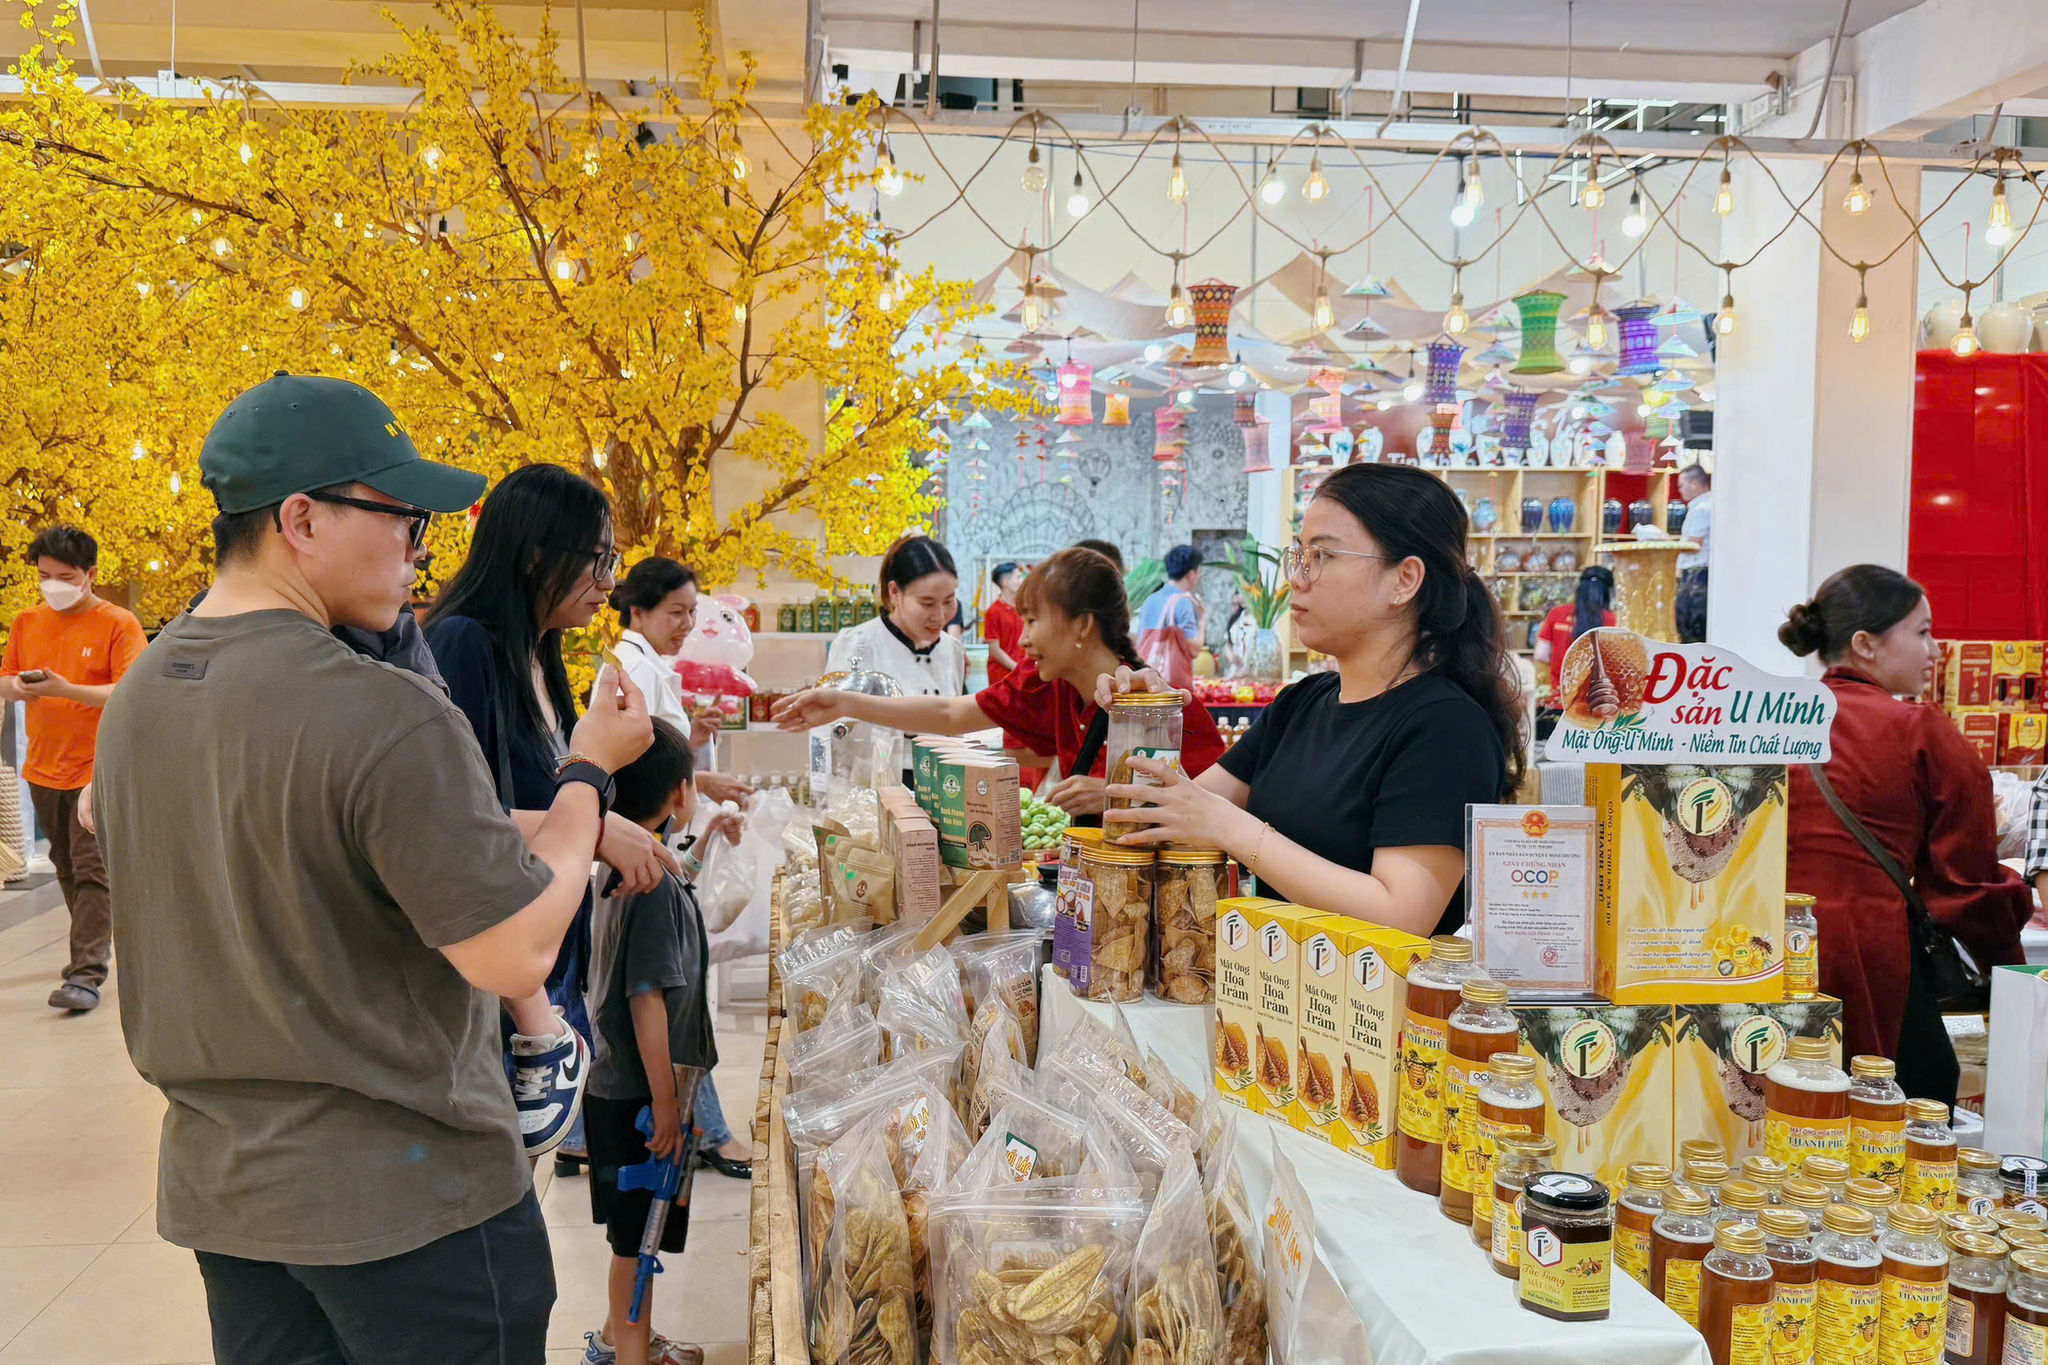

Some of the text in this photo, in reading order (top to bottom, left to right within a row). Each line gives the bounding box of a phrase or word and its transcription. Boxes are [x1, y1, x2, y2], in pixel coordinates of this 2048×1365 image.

[1642, 652, 1733, 704] Đặc
[1670, 697, 1722, 725] sản
[1730, 690, 1825, 725] U Minh
[1562, 730, 1589, 750] Mật
[1593, 730, 1621, 755] Ong
[1623, 732, 1638, 751] U
[1639, 732, 1673, 752] Minh
[1689, 730, 1724, 753] Niềm
[1729, 735, 1746, 754] Tin
[1750, 732, 1780, 755] Chất
[1783, 736, 1823, 760] Lượng
[1511, 869, 1559, 884] OCOP
[1219, 958, 1250, 976] Mật Ong
[1224, 970, 1244, 987] Hoa
[1259, 970, 1290, 989] Mật Ong
[1220, 982, 1248, 1001] Tràm
[1264, 983, 1284, 1000] Hoa
[1304, 983, 1337, 1004] Mật Ong
[1260, 995, 1288, 1015] Tràm
[1309, 996, 1331, 1016] Hoa
[1350, 998, 1384, 1021] Mật Ong
[1305, 1009, 1336, 1032] Tràm
[1355, 1012, 1377, 1032] Hoa
[1349, 1024, 1382, 1049] Tràm
[1789, 1136, 1825, 1149] THANH
[1862, 1143, 1896, 1154] THANH
[1900, 1291, 1929, 1302] THANH
